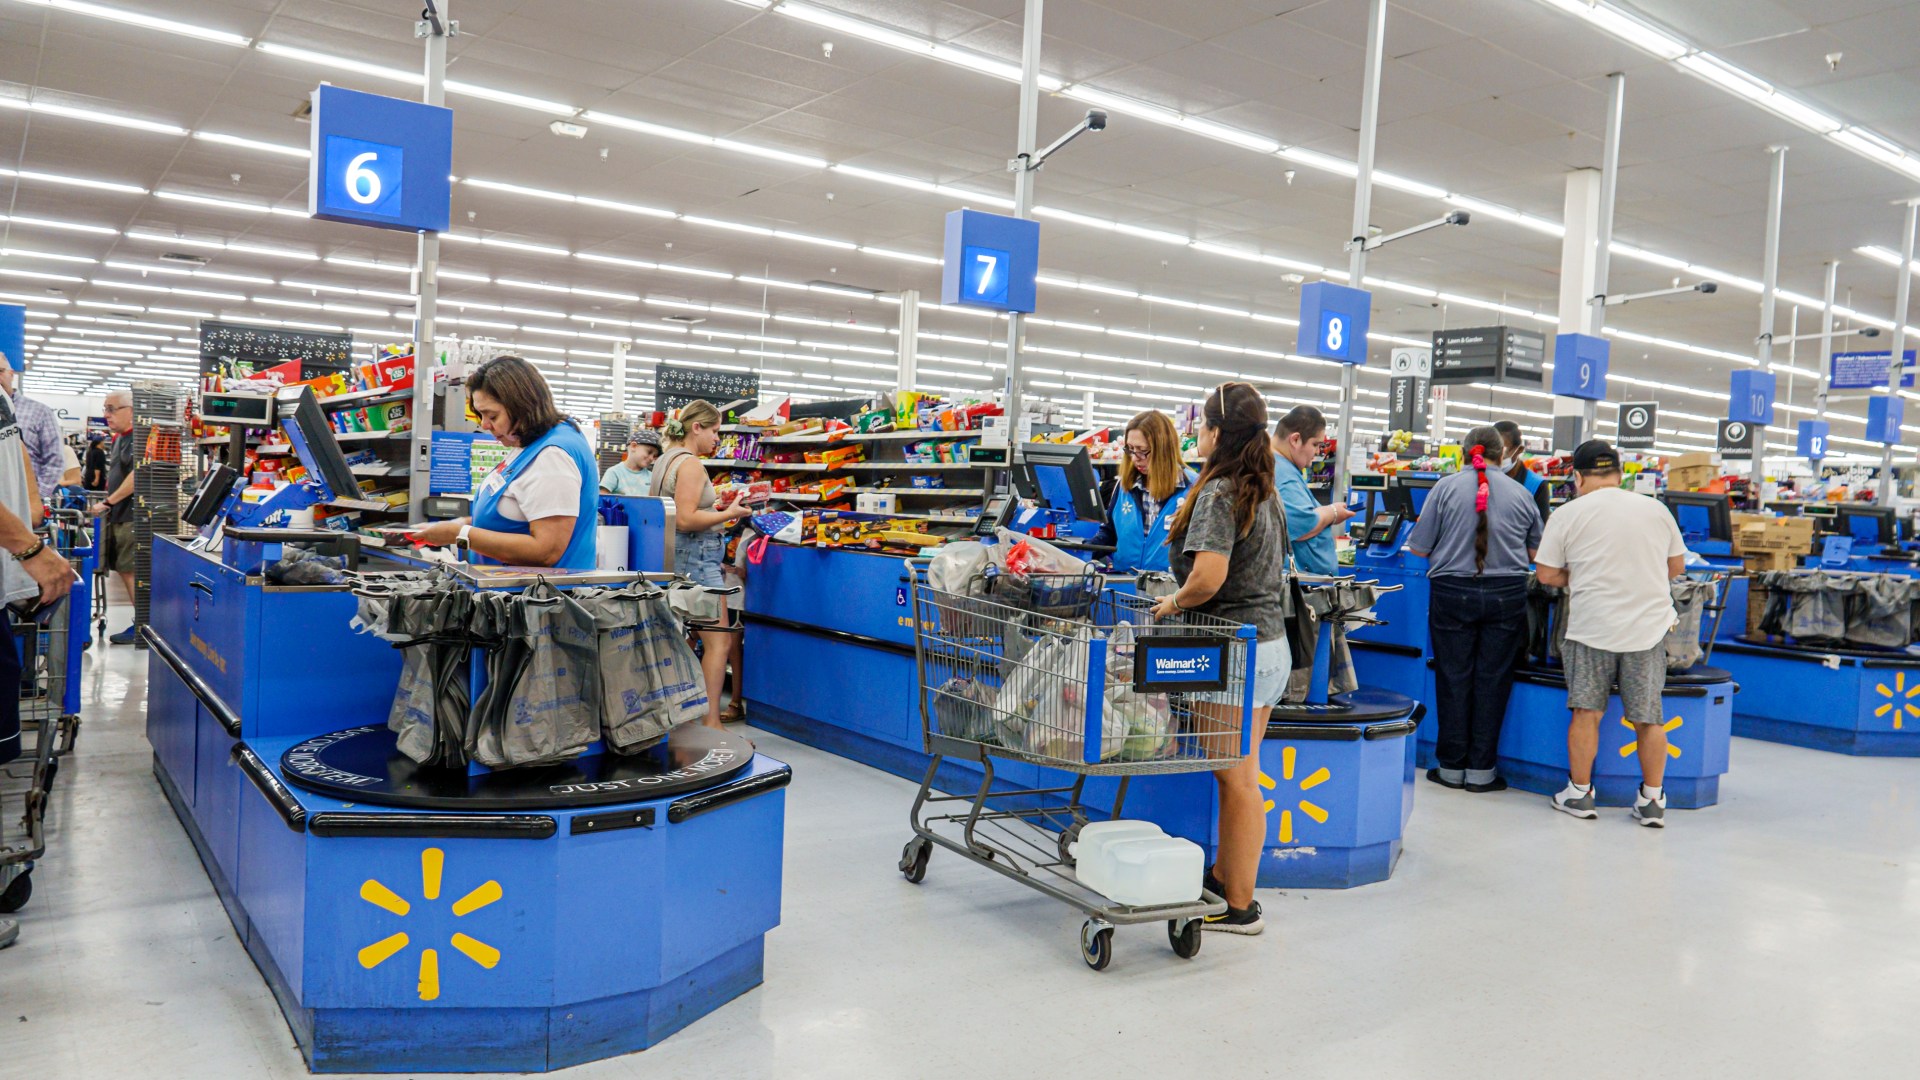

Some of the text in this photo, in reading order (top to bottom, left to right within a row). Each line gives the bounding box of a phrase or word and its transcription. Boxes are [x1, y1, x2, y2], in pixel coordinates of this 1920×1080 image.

[346, 152, 381, 204] 6
[977, 254, 997, 294] 7
[1327, 317, 1343, 350] 8
[1581, 363, 1590, 388] 9
[1396, 379, 1407, 413] Home
[1417, 380, 1426, 414] Home
[1752, 394, 1765, 416] 10
[1811, 437, 1822, 454] 12
[1155, 658, 1196, 669] Walmart
[562, 752, 734, 794] JUST ONE MORE
